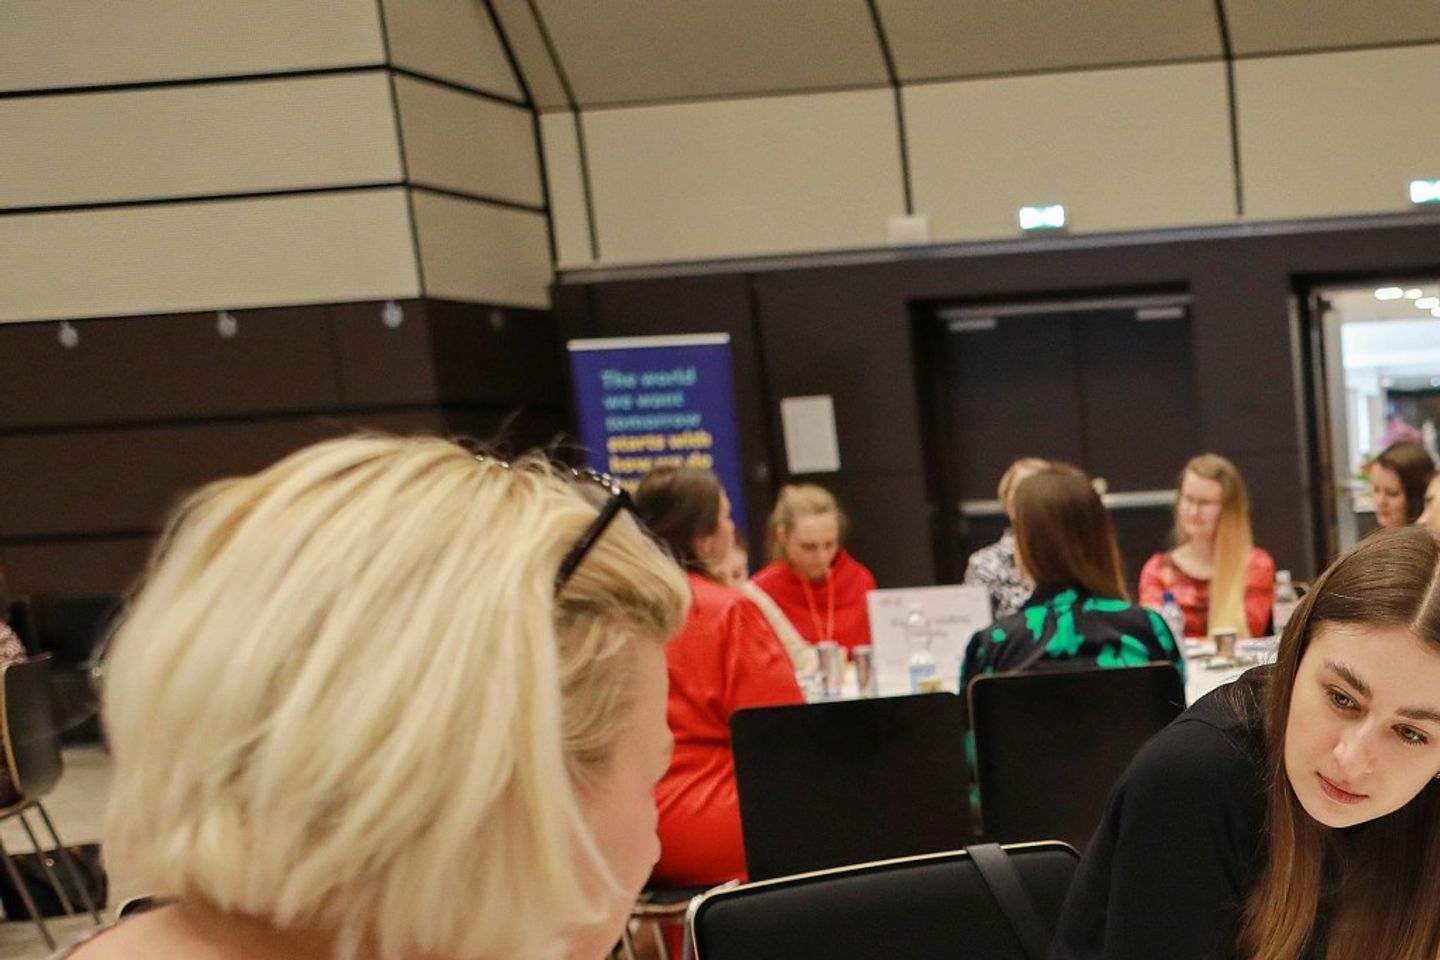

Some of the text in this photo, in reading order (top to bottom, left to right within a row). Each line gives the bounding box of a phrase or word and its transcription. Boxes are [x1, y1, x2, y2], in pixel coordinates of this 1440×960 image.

[601, 367, 697, 389] The world
[604, 391, 684, 410] we want
[605, 414, 702, 432] tomorrow
[607, 430, 713, 453] starts with
